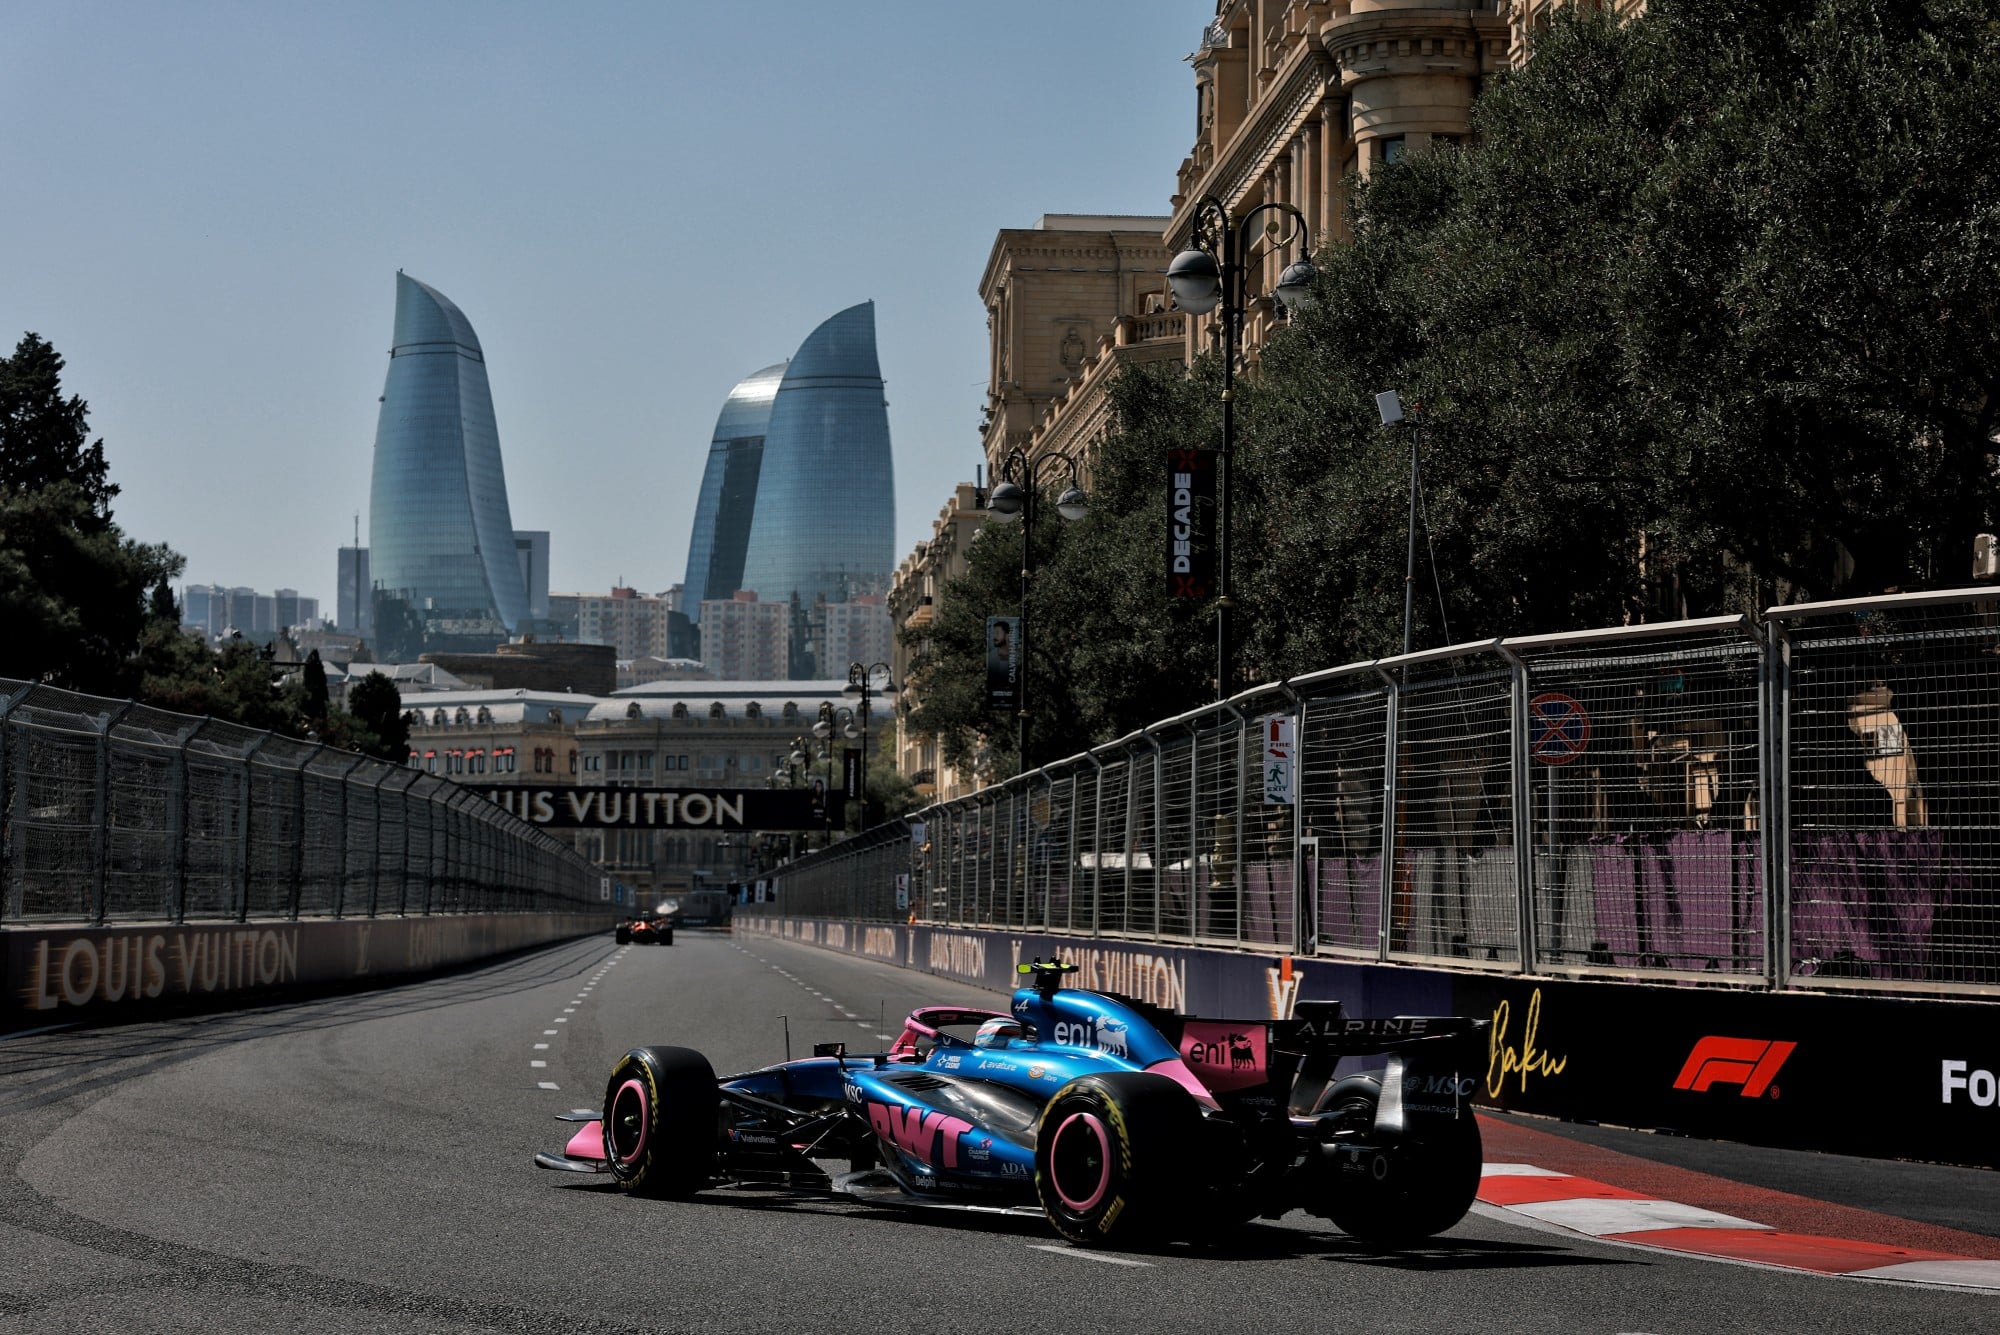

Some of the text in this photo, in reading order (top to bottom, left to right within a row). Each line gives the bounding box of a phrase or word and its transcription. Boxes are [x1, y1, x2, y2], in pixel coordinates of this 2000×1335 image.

[1173, 473, 1191, 573] DECADE
[567, 791, 744, 826] VUITTON
[35, 928, 298, 1011] LOUIS VUITTON
[1103, 949, 1186, 1016] VUITTON
[1054, 1016, 1093, 1049] eni
[1296, 1019, 1429, 1037] ALPINE
[1486, 986, 1568, 1099] Baku
[1190, 1036, 1226, 1065] eni
[1672, 1035, 1798, 1098] F1
[844, 1082, 863, 1104] MSC
[1422, 1074, 1476, 1097] MSC
[1942, 1059, 2000, 1107] Fo
[740, 1134, 777, 1144] Valvoline
[915, 1175, 936, 1189] Delphi
[1001, 1162, 1028, 1175] ADA
